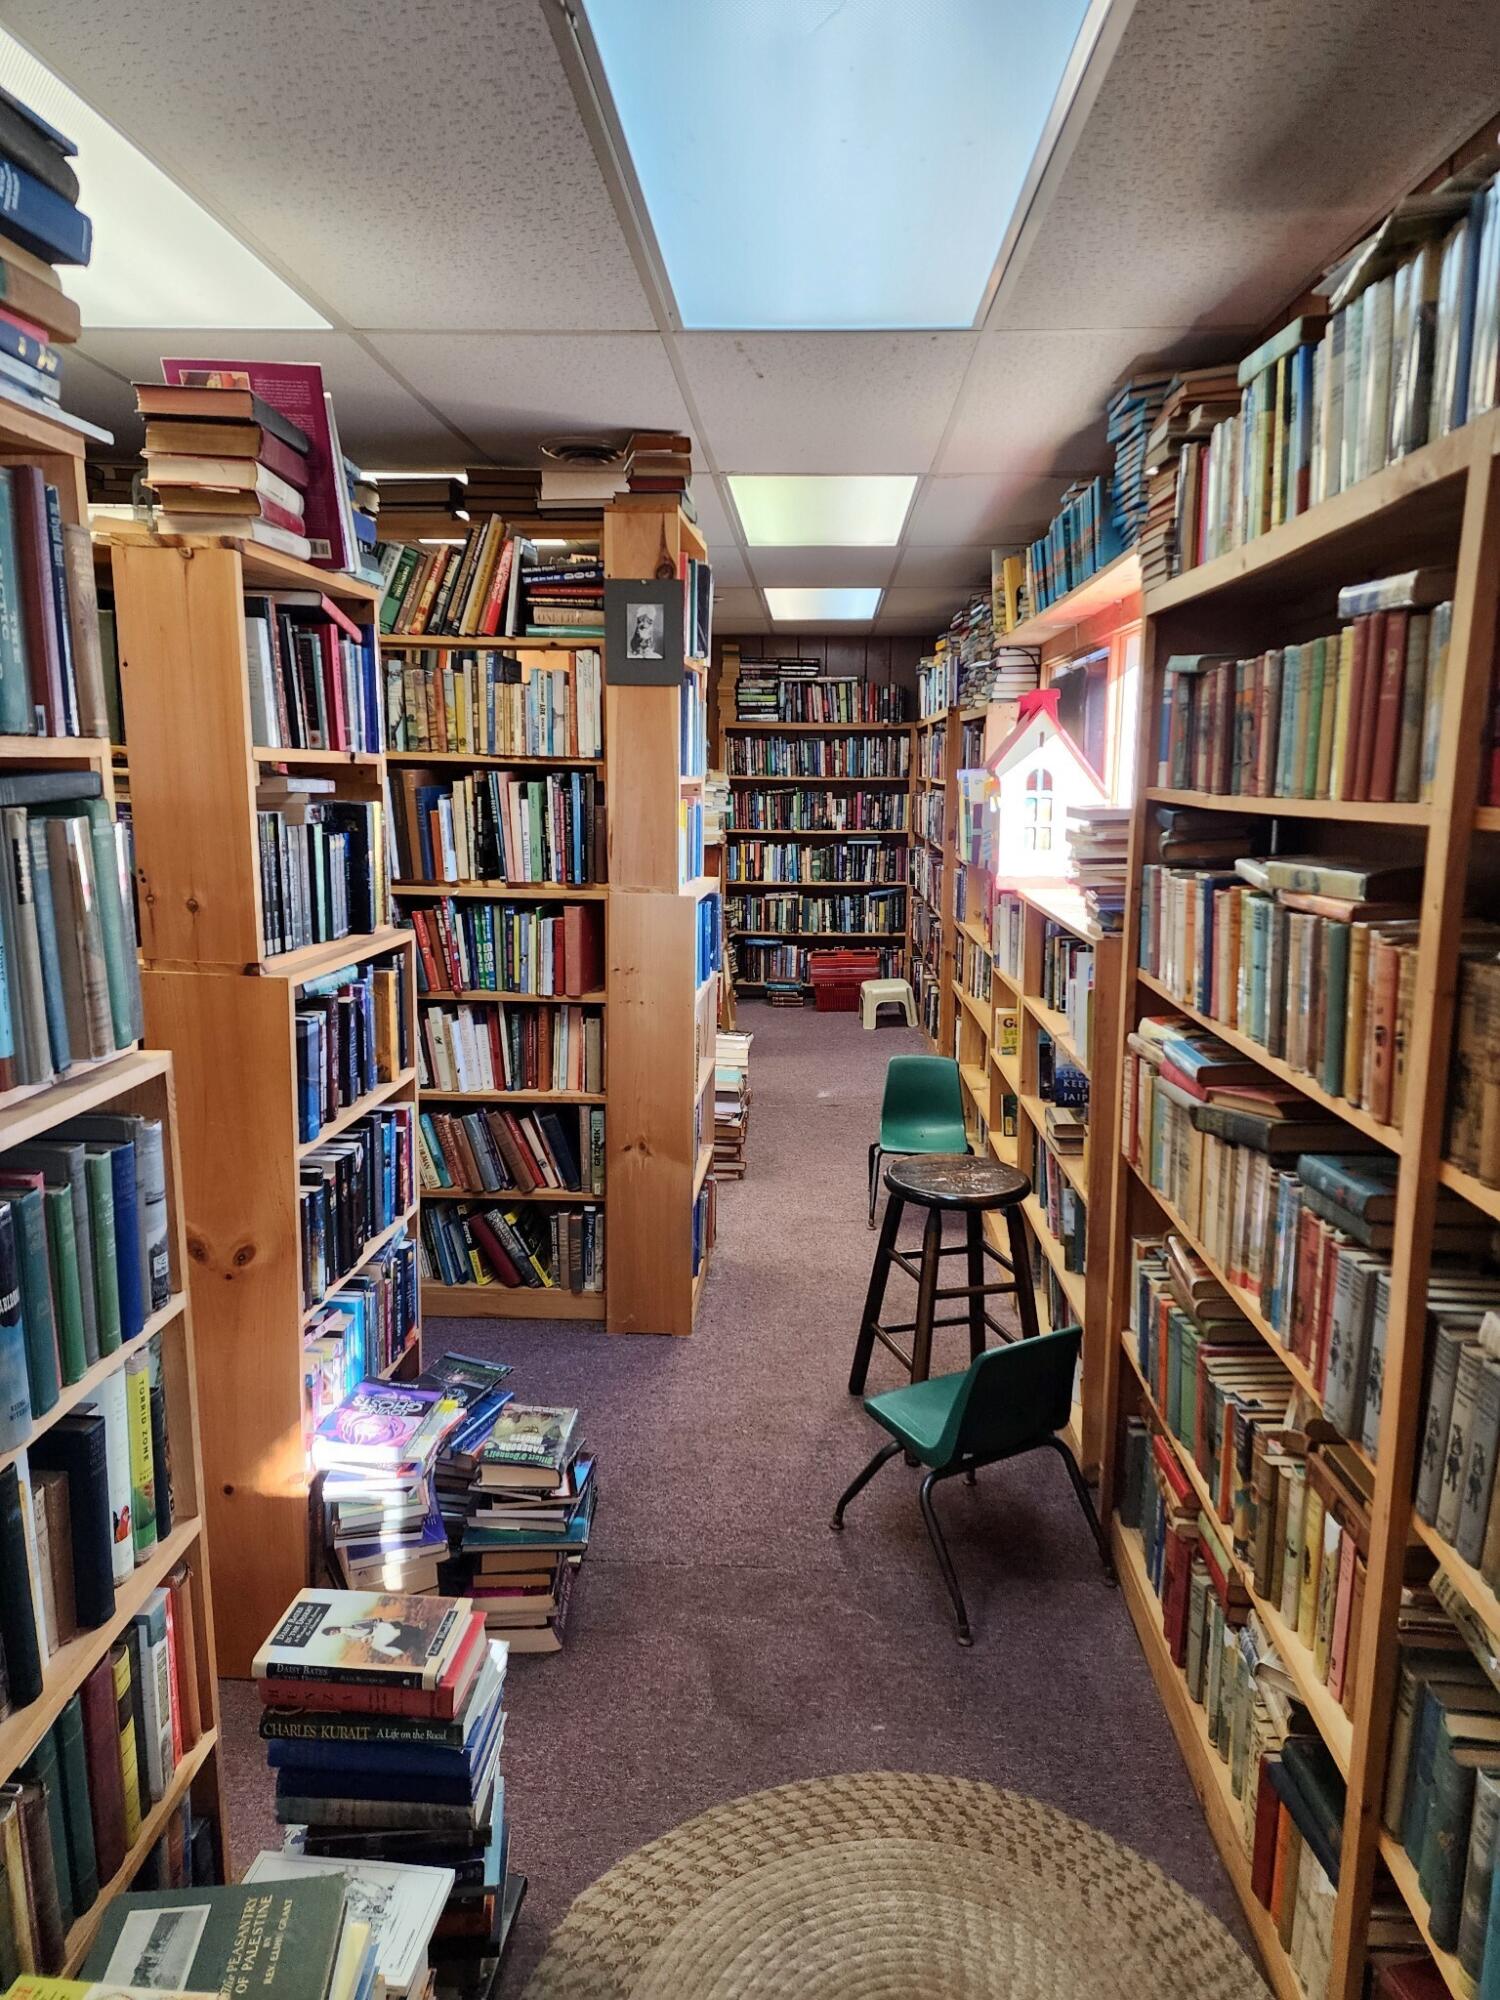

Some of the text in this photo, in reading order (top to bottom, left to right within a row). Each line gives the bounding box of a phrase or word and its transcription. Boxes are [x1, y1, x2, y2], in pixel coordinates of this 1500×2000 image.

[462, 1221, 473, 1244] Ferrets
[139, 1379, 147, 1424] TORRID
[352, 1397, 423, 1412] GHOSTS
[359, 1406, 408, 1416] LOVING
[276, 1663, 328, 1676] DAISY BATES
[263, 1723, 370, 1740] CHARLES KURALT
[376, 1730, 385, 1738] A
[385, 1730, 401, 1740] Life
[412, 1731, 425, 1740] the
[426, 1732, 447, 1740] Road
[226, 1896, 258, 1973] PEASANTRY
[235, 1894, 273, 1994] OF PALESTINE
